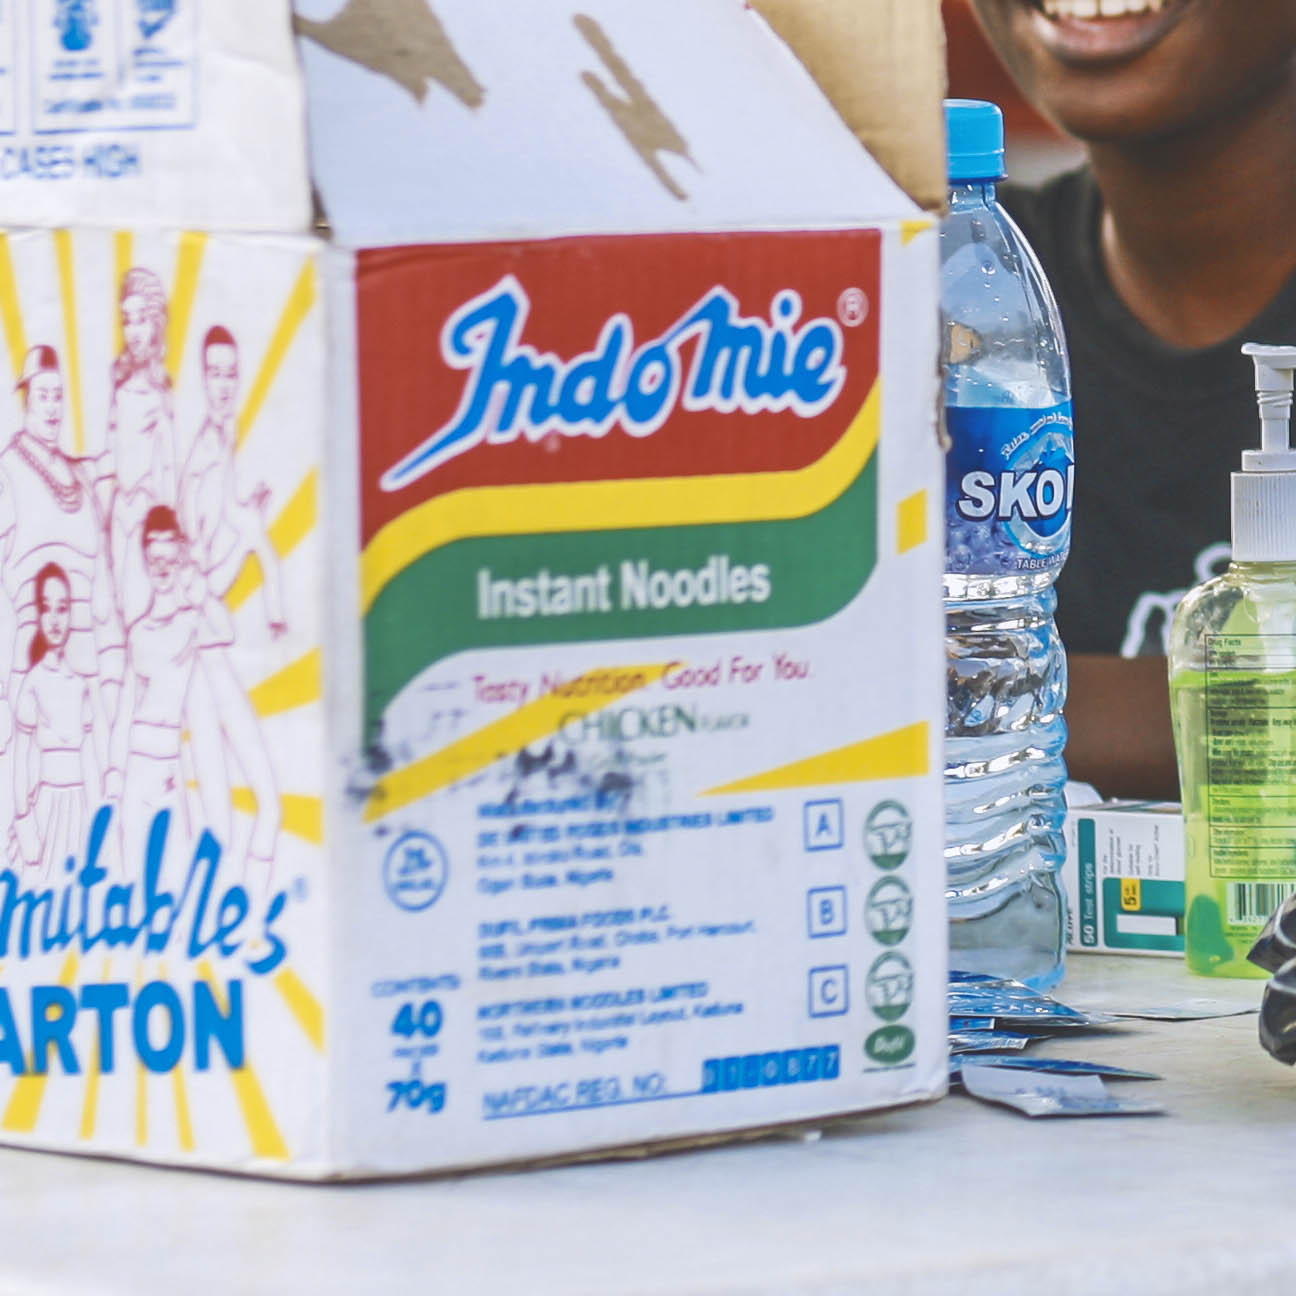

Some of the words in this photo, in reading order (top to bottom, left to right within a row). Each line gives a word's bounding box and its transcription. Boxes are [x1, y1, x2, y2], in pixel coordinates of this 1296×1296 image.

[1016, 558, 1047, 570] TABLE
[476, 566, 612, 620] Instant
[620, 554, 772, 615] Noodles
[473, 673, 529, 707] Tasty
[540, 670, 648, 700] Nutrition
[661, 658, 722, 691] Good
[728, 655, 764, 684] For
[773, 652, 812, 681] You
[558, 702, 697, 746] CHICKEN
[816, 811, 833, 838] A
[819, 898, 835, 926] B
[821, 977, 839, 1006] C
[391, 999, 444, 1040] 40
[386, 1078, 448, 1115] 70g
